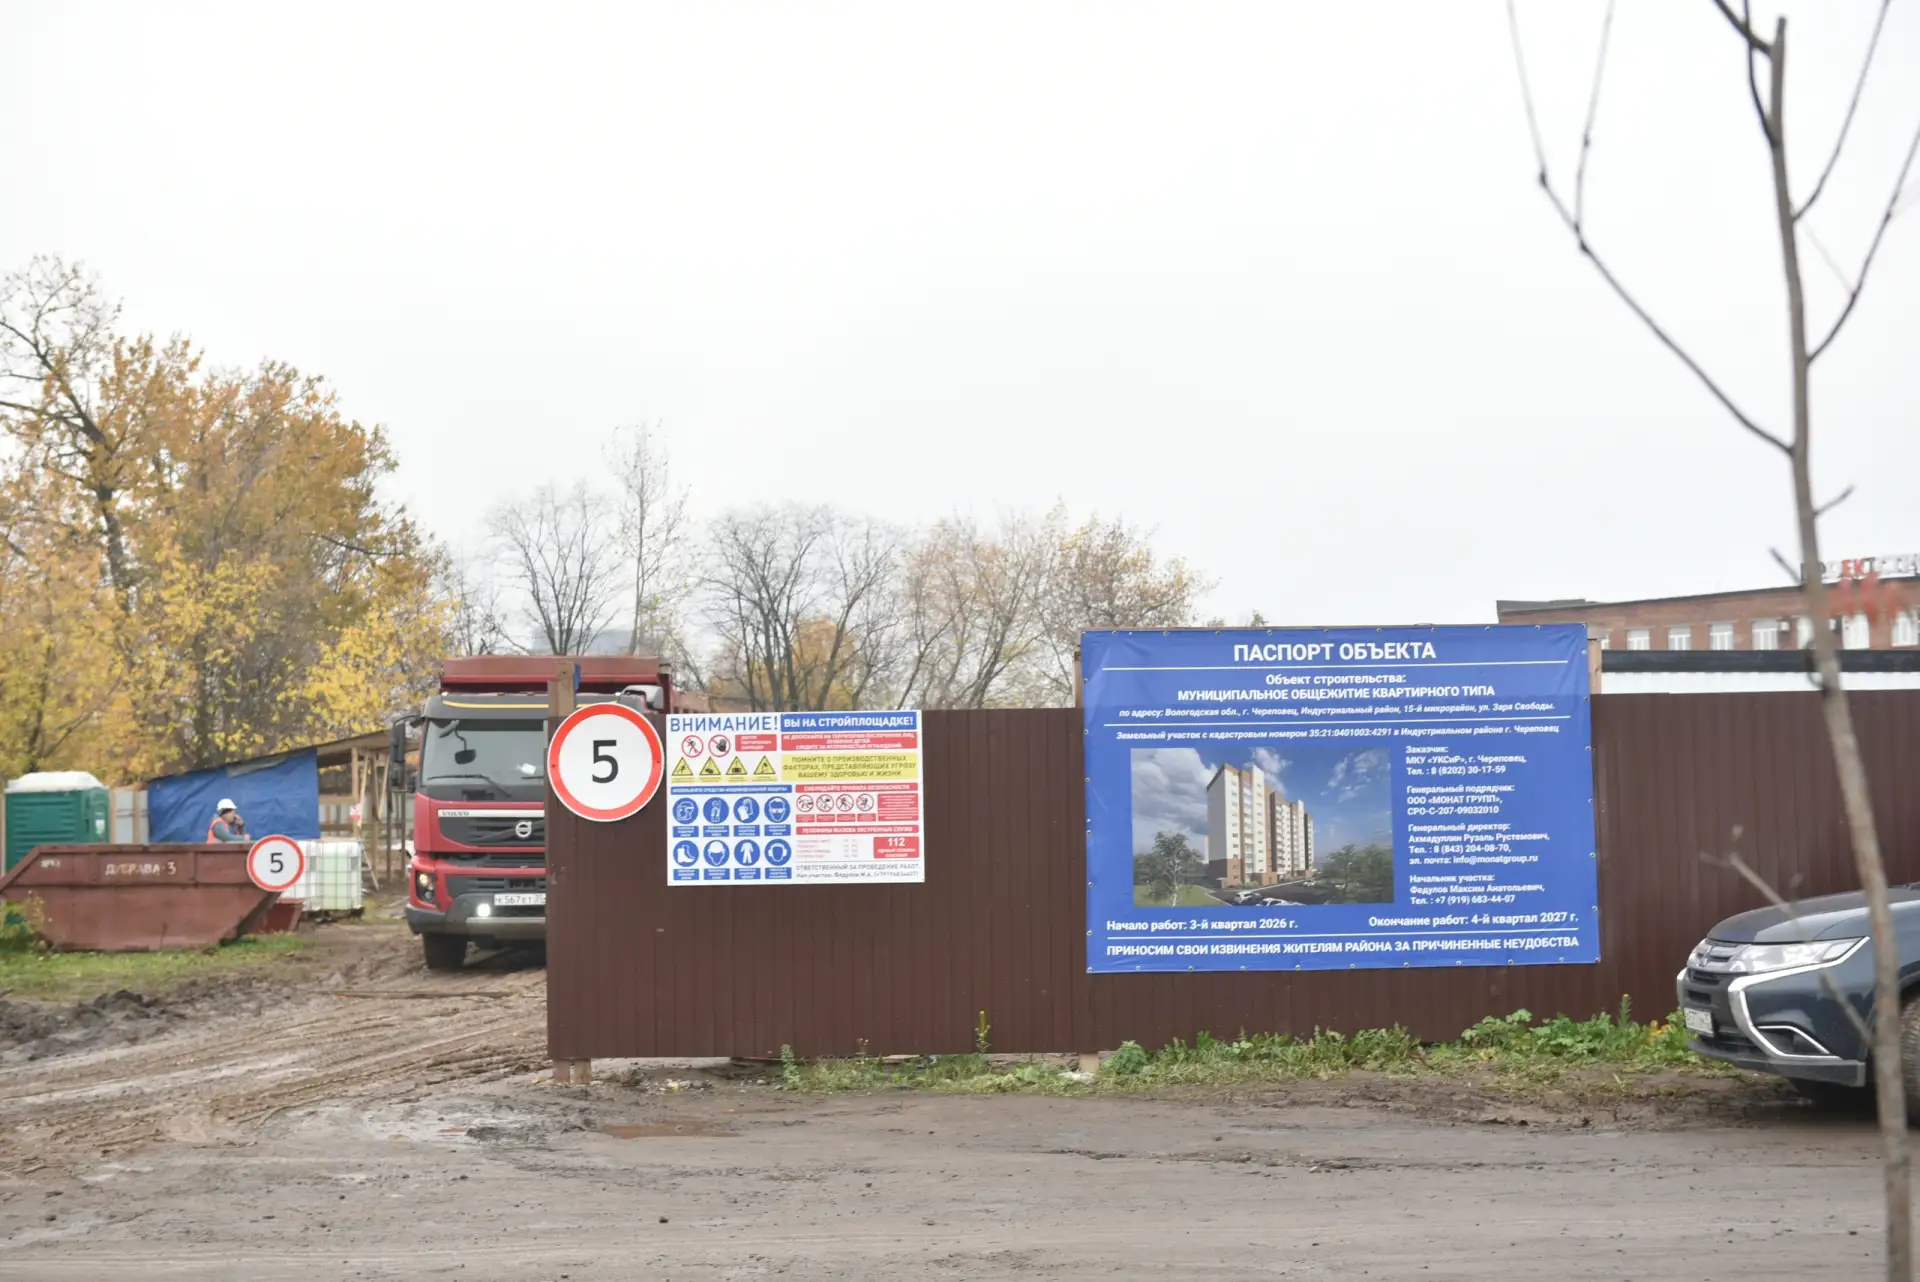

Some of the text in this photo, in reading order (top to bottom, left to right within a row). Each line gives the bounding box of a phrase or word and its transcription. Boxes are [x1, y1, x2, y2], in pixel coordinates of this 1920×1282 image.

[1233, 642, 1437, 662] ПАСПОРТ ОБЪЕКТА
[1265, 673, 1407, 686] Объект строительства:
[1177, 686, 1496, 702] МУНИЦИПАЛЬНОЕ ОБЩЕЖИТИЕ КВАРТИРНОГО ТИПА
[1118, 709, 1130, 717] по
[1131, 710, 1163, 718] адресу:
[1165, 708, 1219, 717] Вологодская
[1242, 708, 1249, 716] г.
[1252, 707, 1299, 717] Череповец,
[1301, 706, 1373, 717] Индустриальный
[1374, 705, 1402, 715] район,
[1404, 704, 1422, 713] 15-й
[1424, 704, 1477, 714] микрорайон,
[1478, 704, 1490, 713] ул.
[1492, 703, 1513, 712] Заря
[1515, 702, 1556, 711] Свободы.
[670, 716, 778, 732] ВНИМАНИЕ!
[783, 717, 914, 728] ВЫ НА СТРОЙПЛОЩАДКЕ!
[1116, 731, 1165, 740] Земельный
[1167, 731, 1201, 740] участок
[1208, 730, 1267, 740] кадастровым
[1268, 730, 1308, 739] номером
[1309, 728, 1392, 737] 35:21:0401003:4291
[1401, 726, 1473, 736] Индустриальном
[1473, 725, 1504, 735] районе
[1514, 725, 1560, 734] Череповец
[1405, 746, 1448, 754] Заказчик:
[592, 739, 619, 784] 5
[1406, 756, 1425, 764] МКУ
[1477, 755, 1527, 764] Череповец,
[1406, 767, 1425, 775] Тел.
[1438, 766, 1466, 776] (8202)
[1468, 765, 1506, 774] 30-17-59
[1406, 785, 1515, 794] Генеральный подрядчик:
[1428, 796, 1464, 804] «МОНАТ
[1407, 806, 1499, 815] СРО-С-207-09032010
[1408, 823, 1511, 833] Генеральный директор:
[887, 837, 906, 847] 112
[1408, 833, 1550, 844] Ахмадуллин Рузаль Рустемович,
[1441, 845, 1464, 854] (843)
[269, 852, 284, 873] 5
[1453, 855, 1538, 865] info@monatgroup.ru
[1409, 875, 1495, 883] Начальник участка:
[1410, 884, 1545, 895] Федулов Максим Анатольевич,
[1410, 897, 1429, 905] Тел.
[1447, 895, 1470, 905] (919)
[1368, 912, 1579, 927] Окончание работ: 4-й квартал 2027 г.
[1107, 919, 1298, 932] Начало работ: 3-й квартал 2026 г.
[1107, 937, 1579, 956] ПРИНОСИМ СВОИ ИЗВИНЕНИЯ ЖИТЕЛЯМ РАЙОНА ЗА ПРИЧИНЕННЫЕ НЕУДОБСТВА
